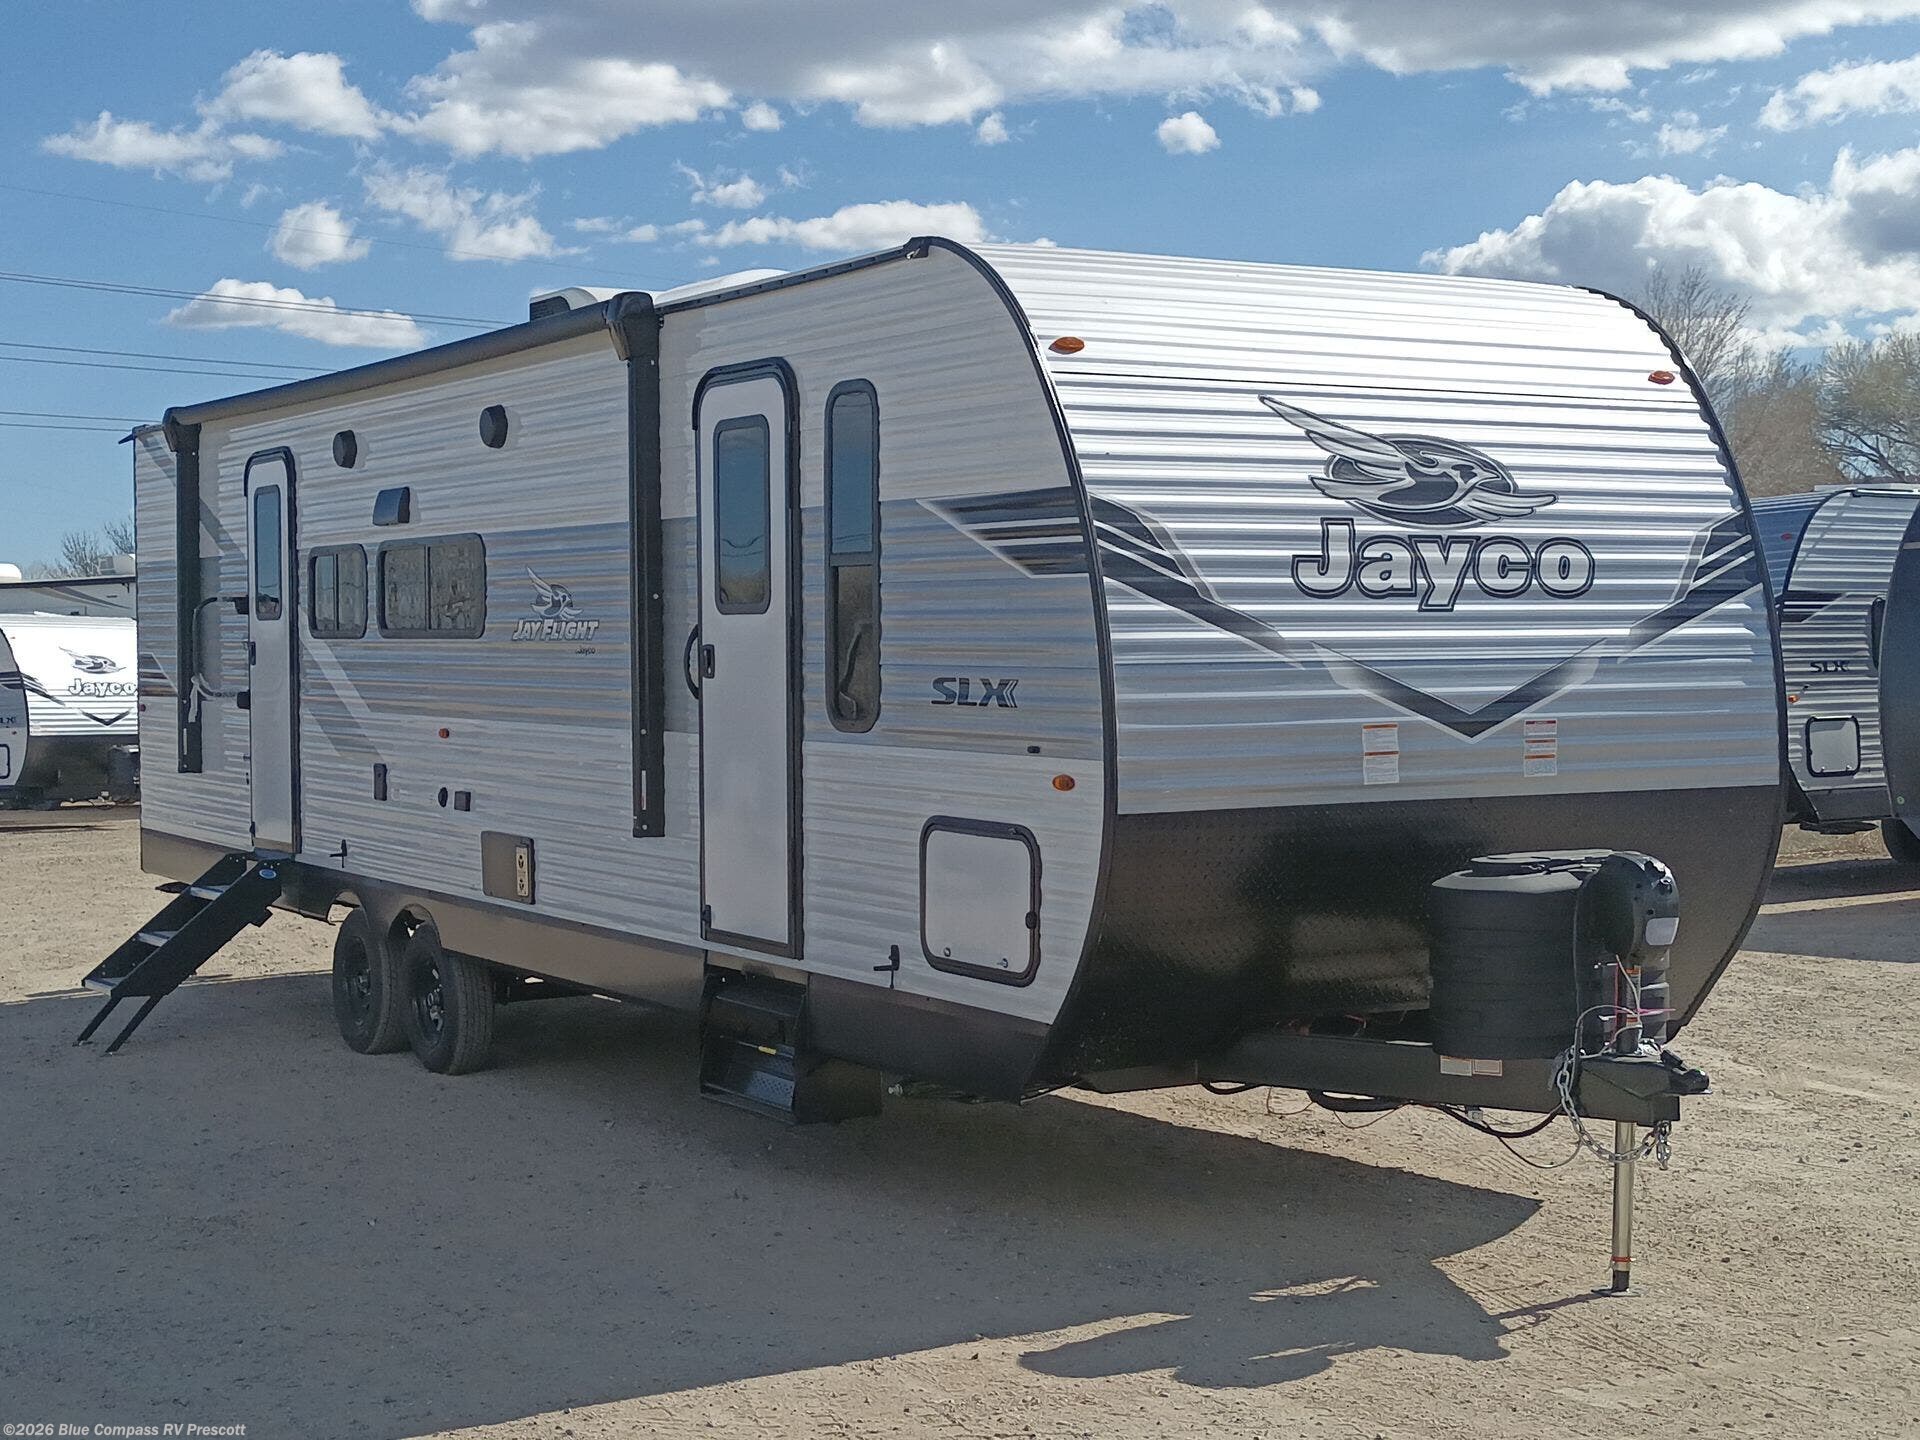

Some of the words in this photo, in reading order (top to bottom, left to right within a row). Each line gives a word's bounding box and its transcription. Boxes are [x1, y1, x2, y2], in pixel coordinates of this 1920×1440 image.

[1291, 517, 1596, 612] Jayco
[511, 618, 543, 641] JAY
[540, 618, 600, 641] FLIGHT
[68, 677, 138, 698] Jayco
[931, 677, 1019, 708] SLX
